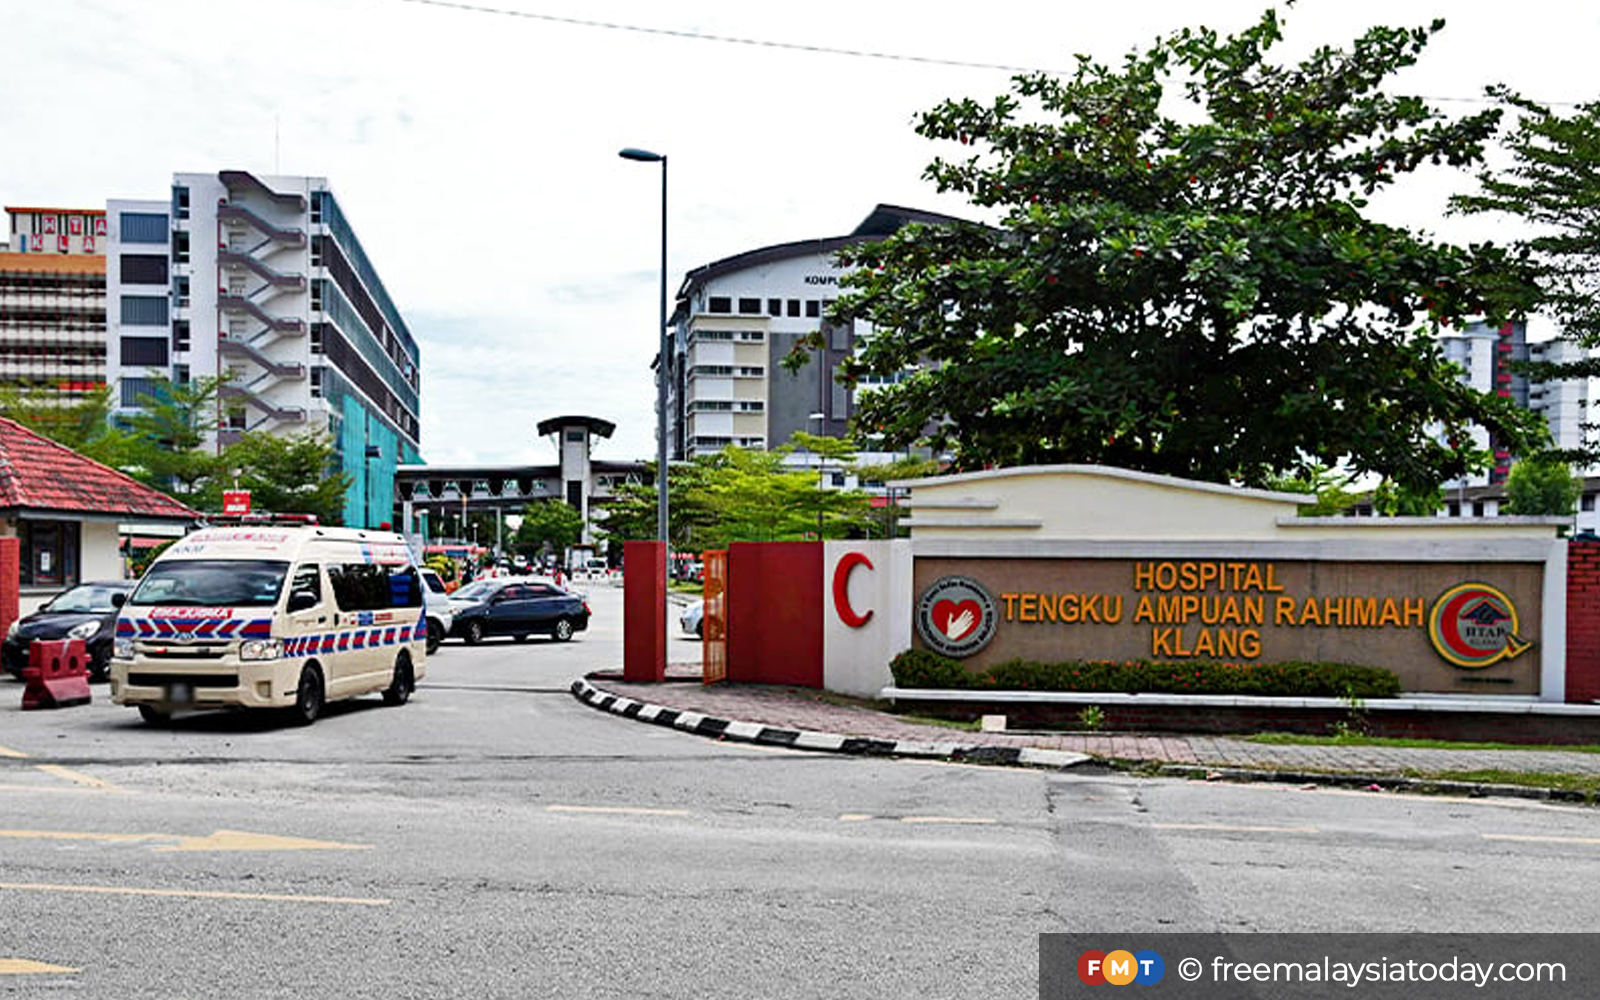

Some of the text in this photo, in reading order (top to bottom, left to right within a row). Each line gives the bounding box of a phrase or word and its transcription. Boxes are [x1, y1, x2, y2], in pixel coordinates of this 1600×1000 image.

[44, 217, 107, 235] HTA
[31, 234, 94, 252] KLA
[1135, 561, 1284, 592] HOSPITAL
[1001, 593, 1123, 624] TENGKU
[1134, 595, 1264, 625] AMPUAN
[1275, 596, 1424, 627] RAHIMAH
[1152, 627, 1261, 657] KLANG
